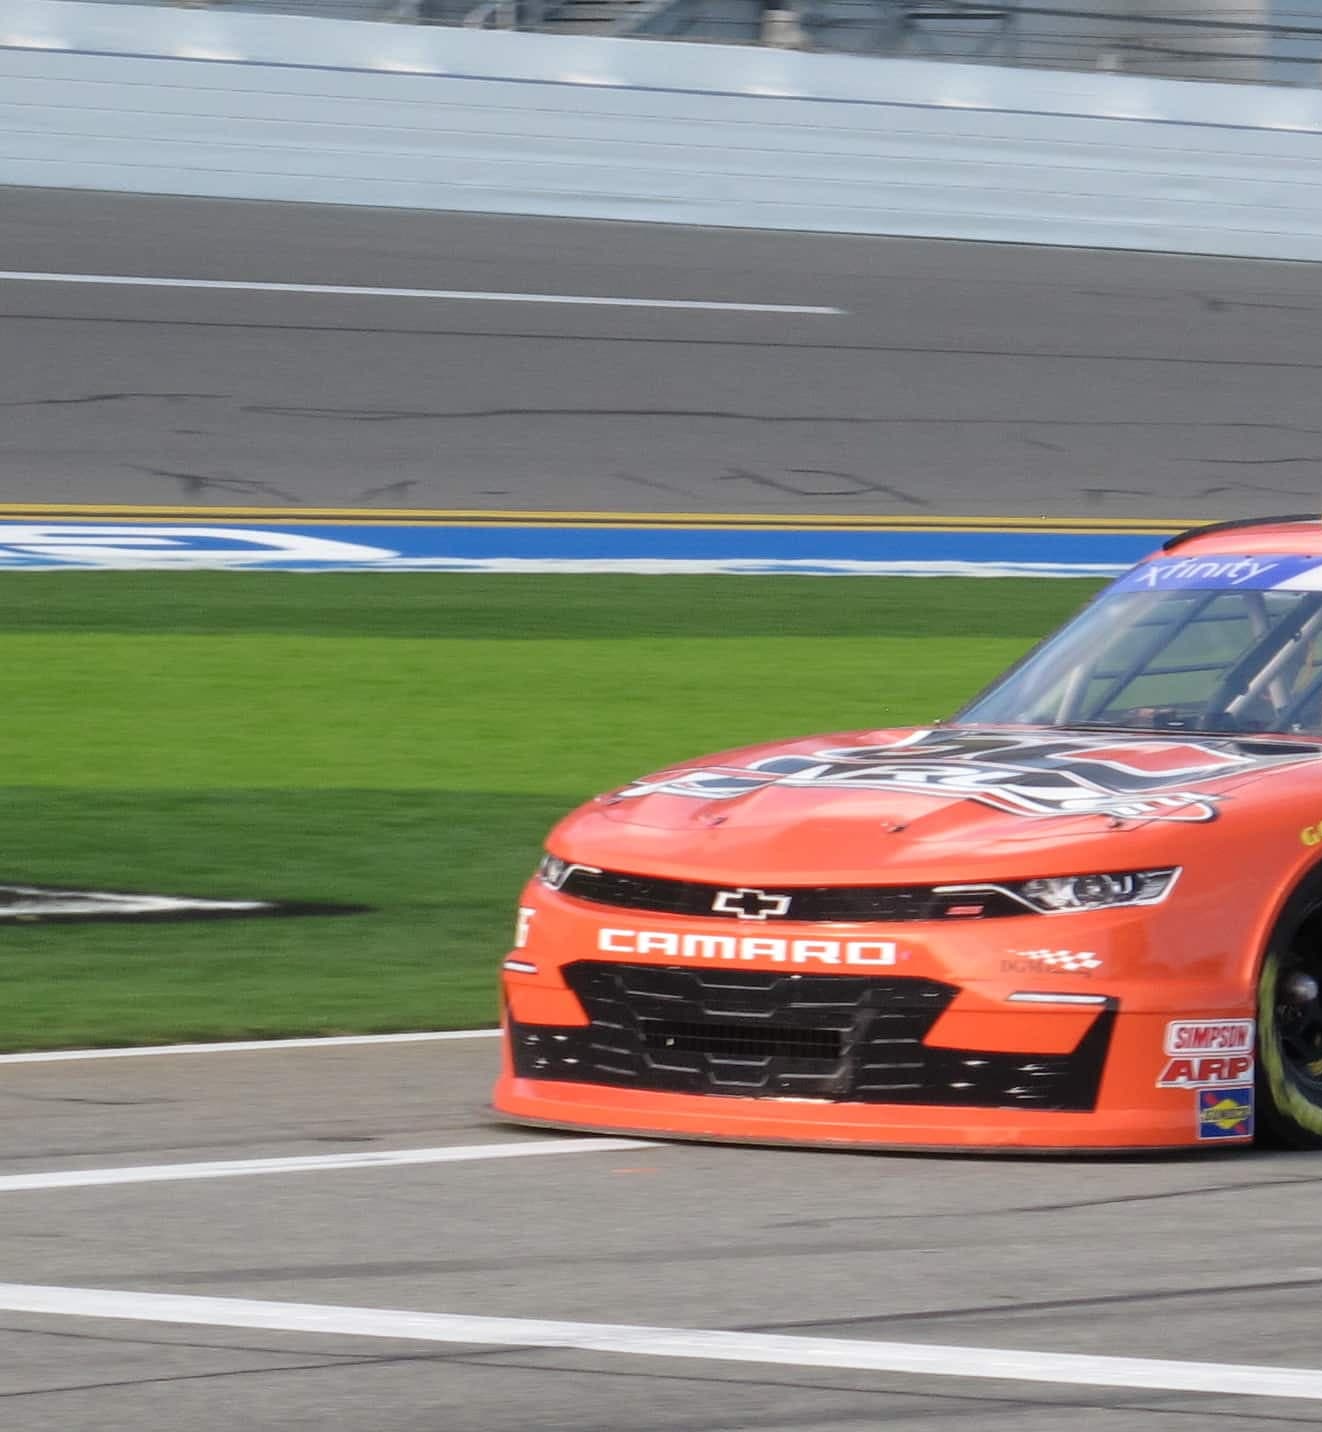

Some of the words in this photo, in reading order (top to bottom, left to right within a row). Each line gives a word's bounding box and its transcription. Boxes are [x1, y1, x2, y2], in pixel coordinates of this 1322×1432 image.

[1134, 558, 1280, 587] xfinity
[598, 927, 897, 966] CAMARO
[1174, 1026, 1249, 1050] SIMPSON
[1160, 1057, 1250, 1082] ARP
